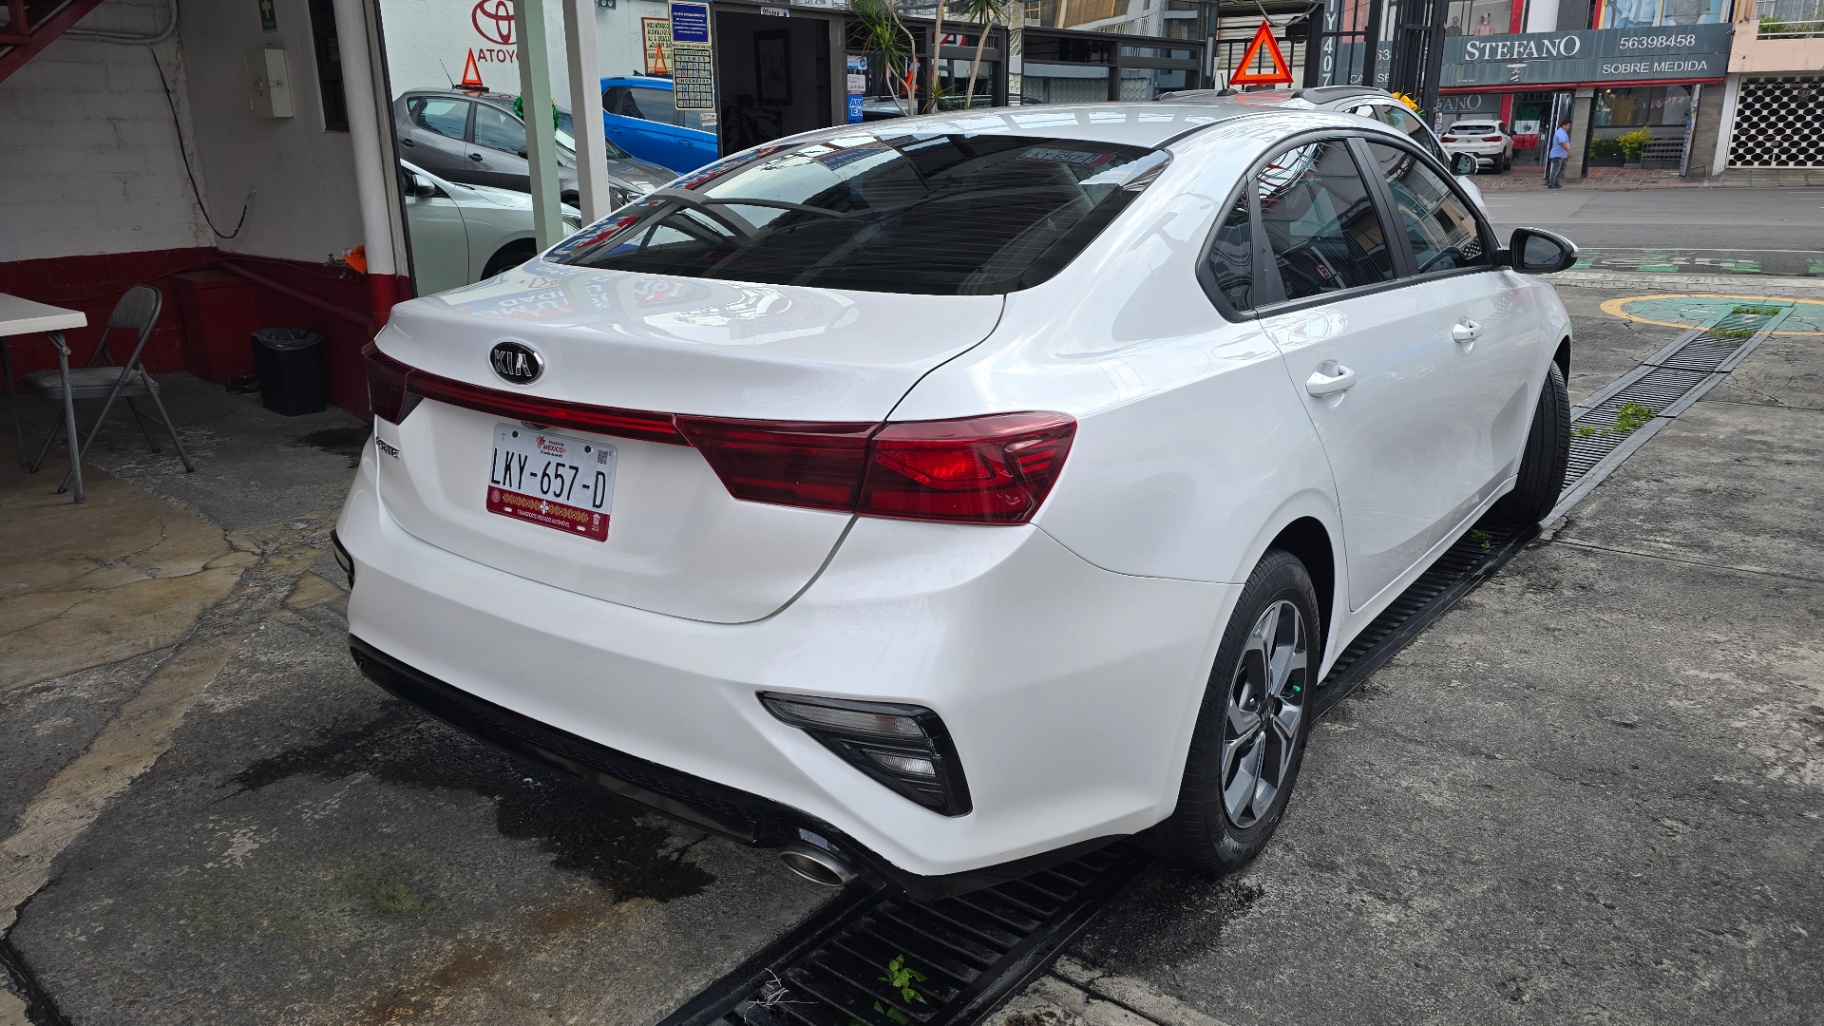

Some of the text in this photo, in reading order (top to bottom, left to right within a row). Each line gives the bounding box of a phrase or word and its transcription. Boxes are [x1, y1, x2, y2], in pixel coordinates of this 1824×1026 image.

[1465, 35, 1580, 61] STEFANO
[1619, 34, 1696, 50] 56398458
[1602, 60, 1708, 74] SOBRE MEDIDA
[494, 349, 532, 376] KIA
[491, 448, 606, 509] LKY-657-D
